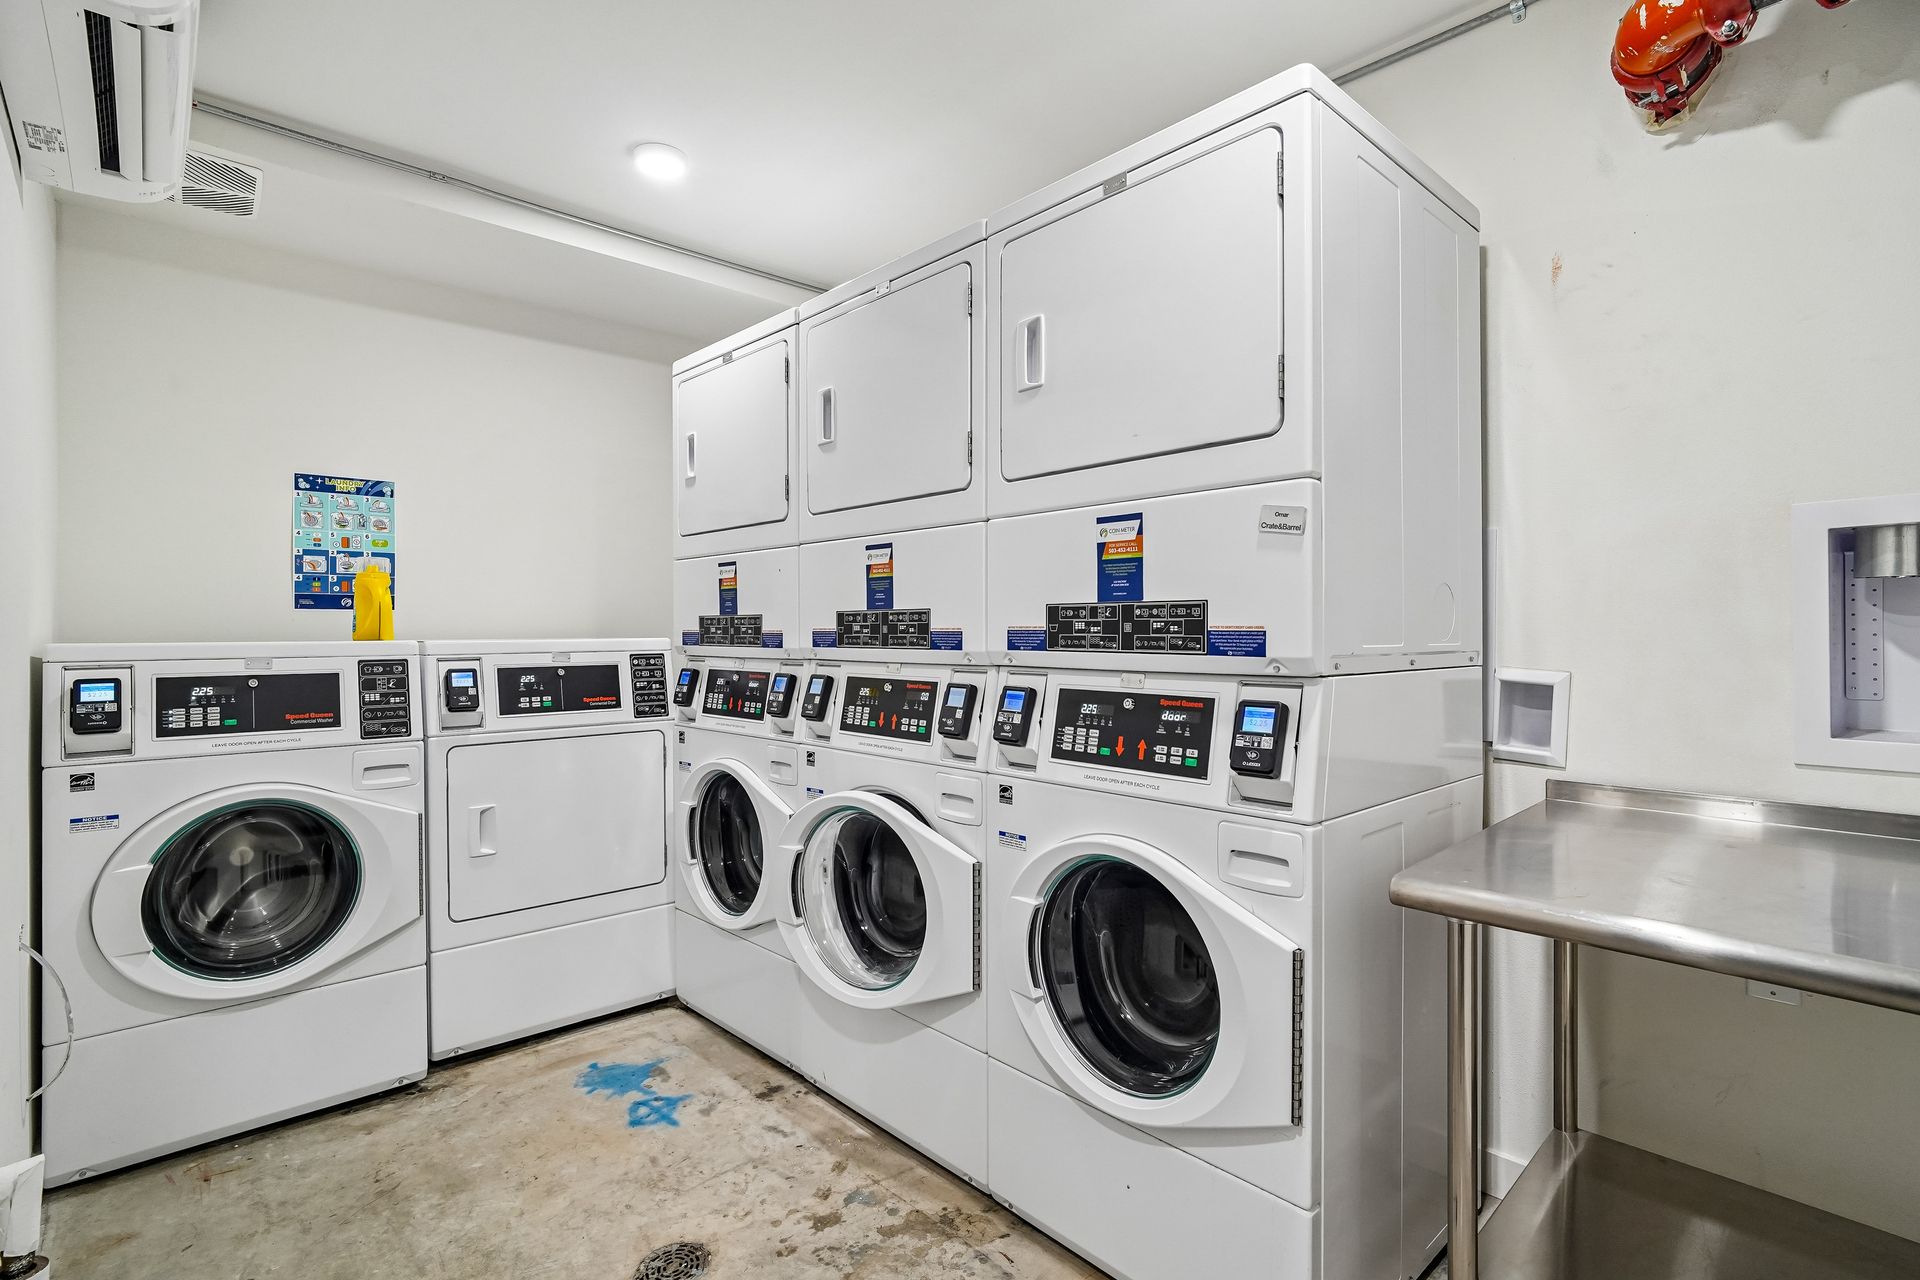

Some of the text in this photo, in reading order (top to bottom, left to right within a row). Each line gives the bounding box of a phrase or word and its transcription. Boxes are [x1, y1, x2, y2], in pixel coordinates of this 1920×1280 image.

[325, 477, 366, 487] LAUNDRY
[1108, 525, 1136, 535] COIN METER
[1261, 521, 1302, 531] Crate&Barrel
[1160, 698, 1204, 708] Speed Queen
[1161, 710, 1187, 721] door
